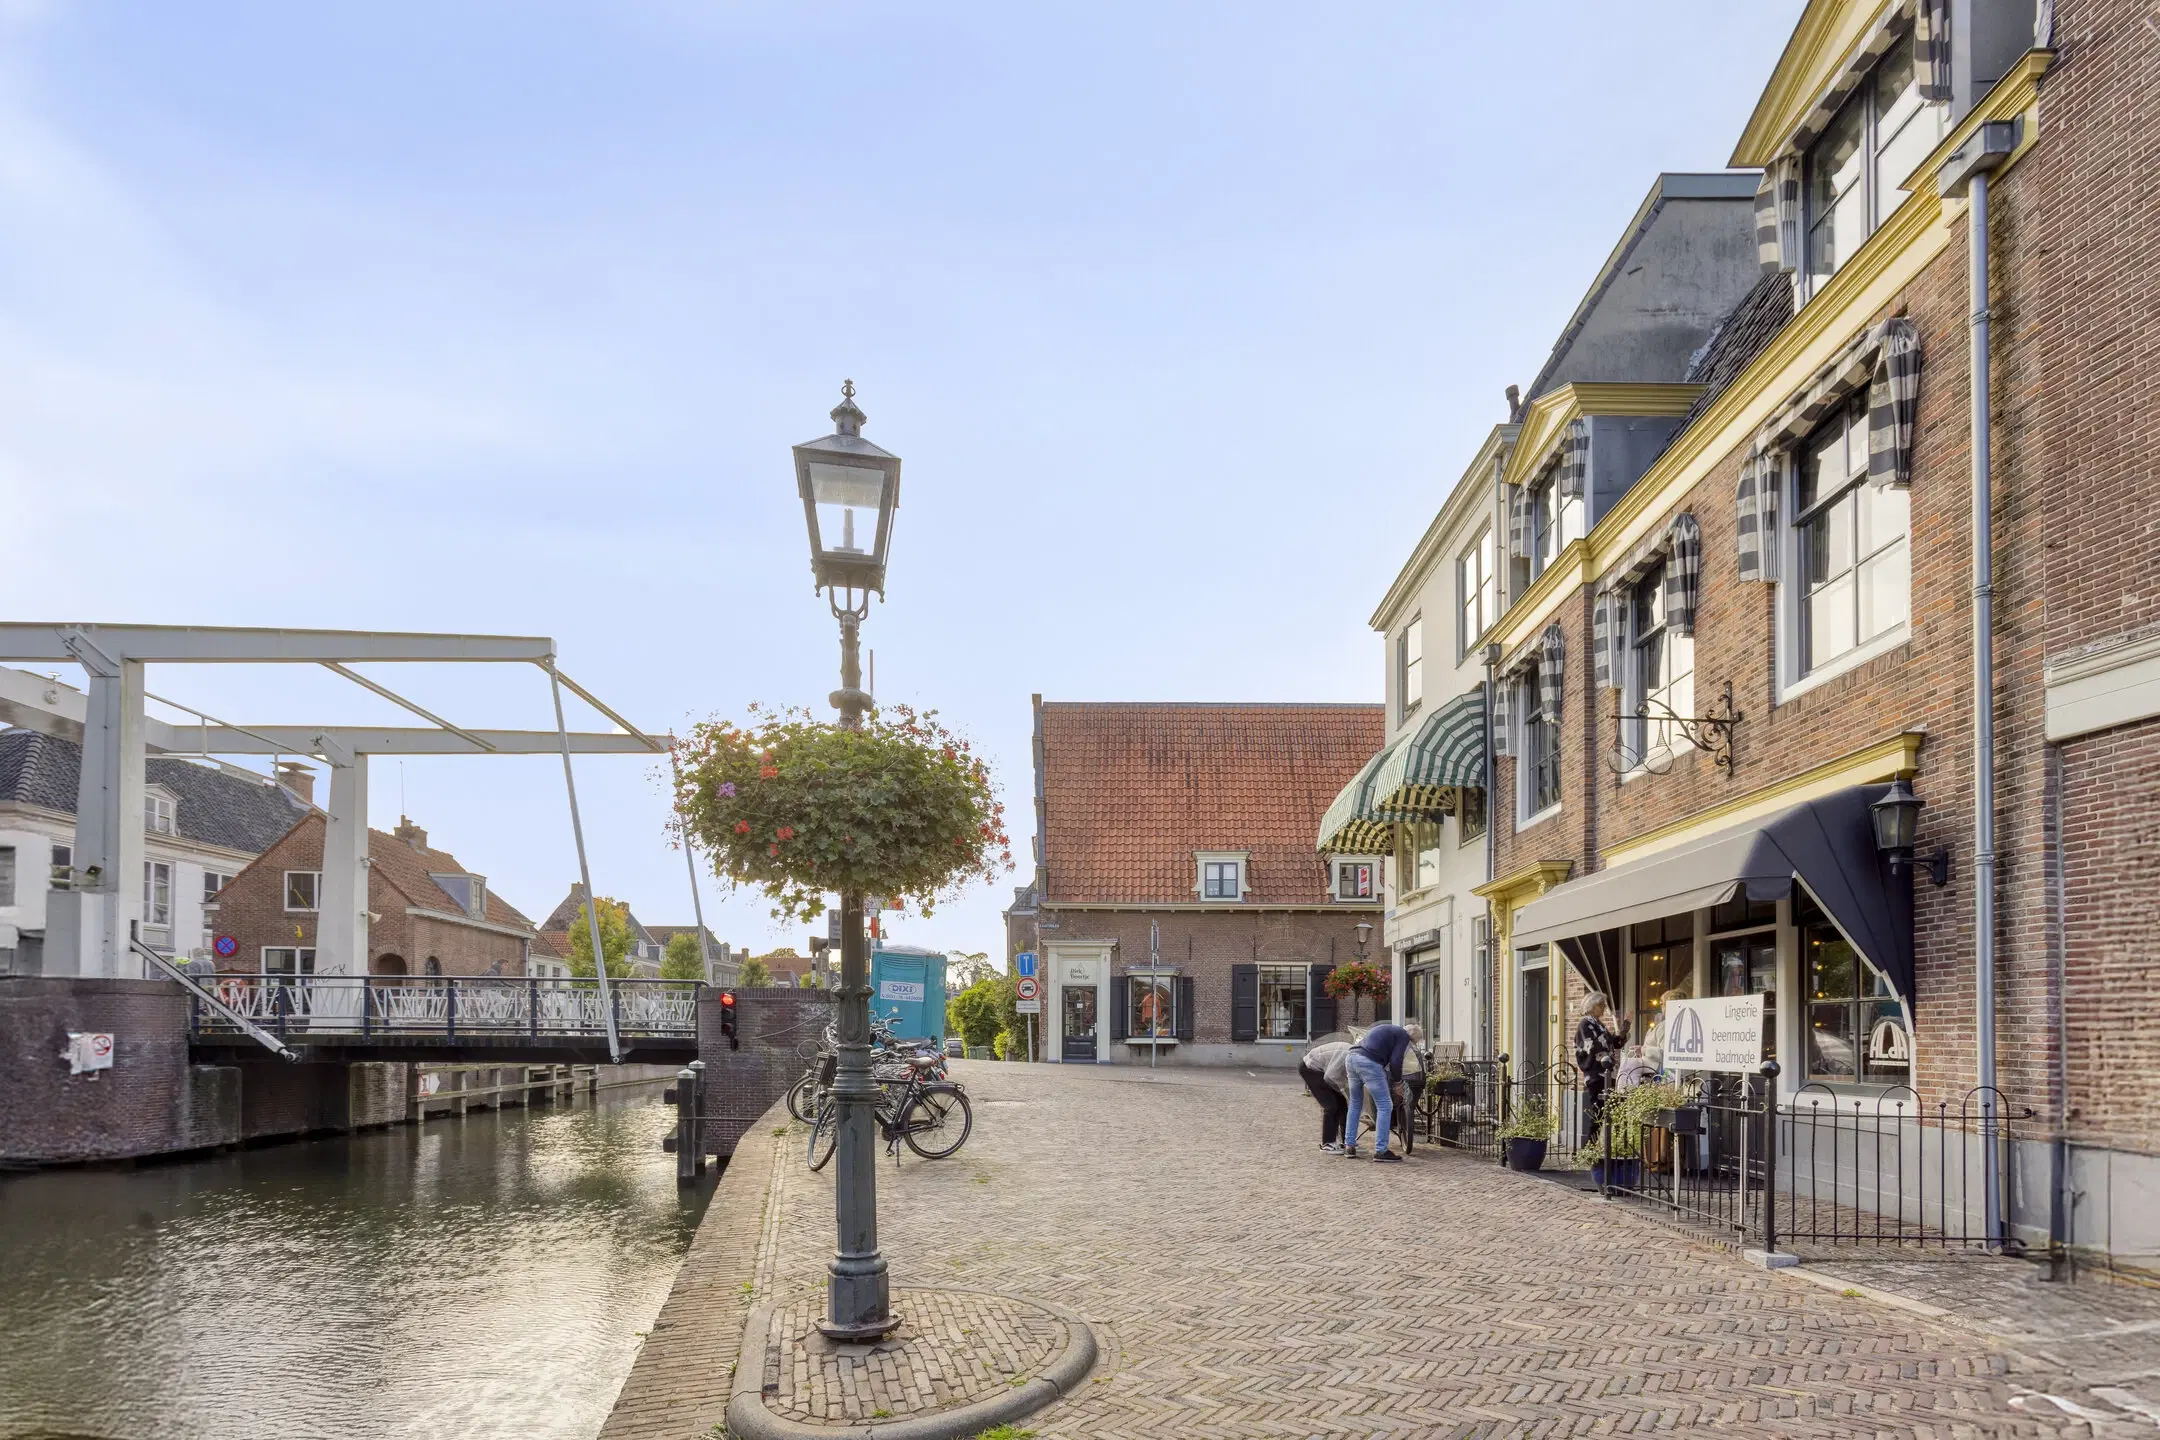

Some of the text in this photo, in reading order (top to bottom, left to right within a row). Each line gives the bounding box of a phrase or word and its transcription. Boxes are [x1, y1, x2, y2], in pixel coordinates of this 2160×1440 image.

[1724, 1004, 1758, 1021] Lingerie
[1711, 1028, 1757, 1042] beenmode
[1715, 1049, 1756, 1064] badmode
